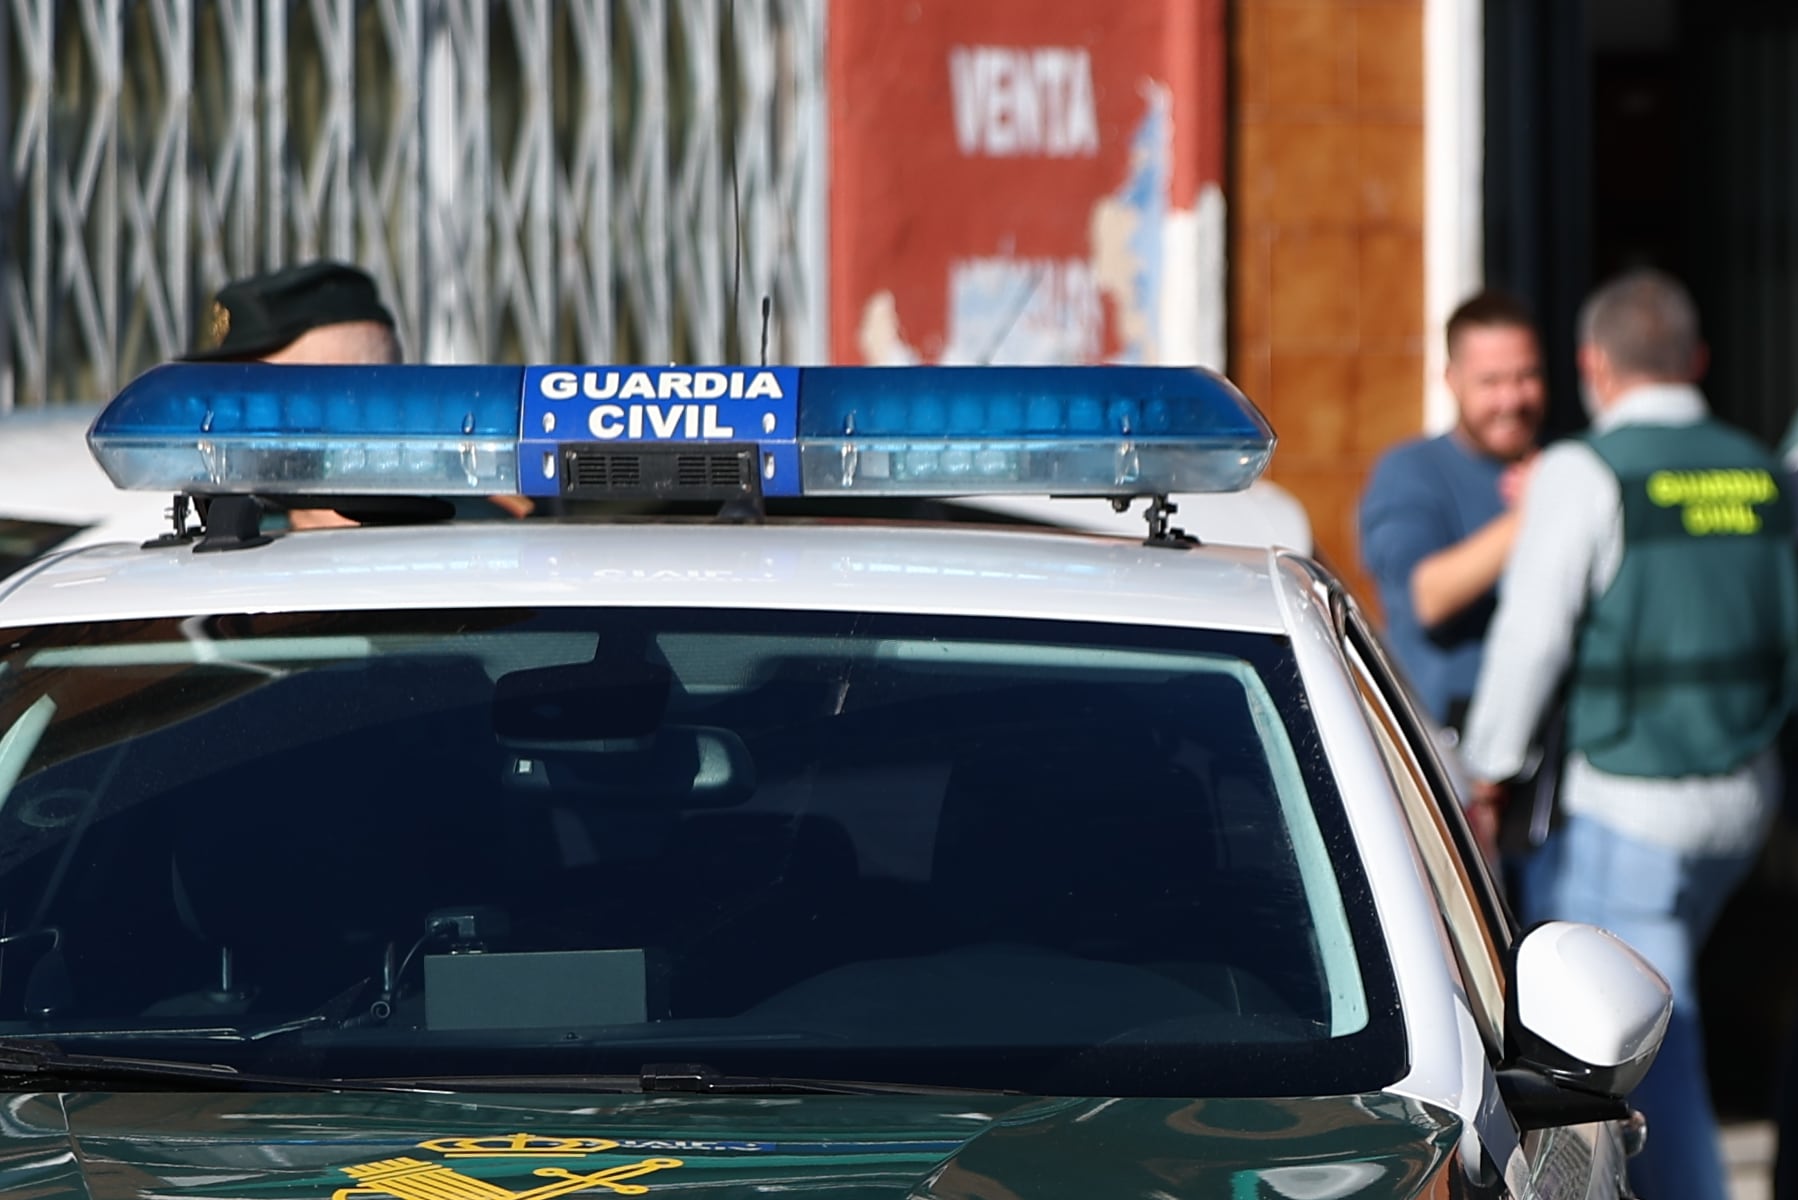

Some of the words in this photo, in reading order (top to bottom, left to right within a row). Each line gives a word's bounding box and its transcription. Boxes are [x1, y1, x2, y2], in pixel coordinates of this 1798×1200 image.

[948, 44, 1101, 158] VENTA
[540, 371, 784, 400] GUARDIA
[588, 404, 734, 439] CIVIL
[1647, 468, 1779, 506] GUARDIA
[1682, 502, 1763, 536] CIVIL
